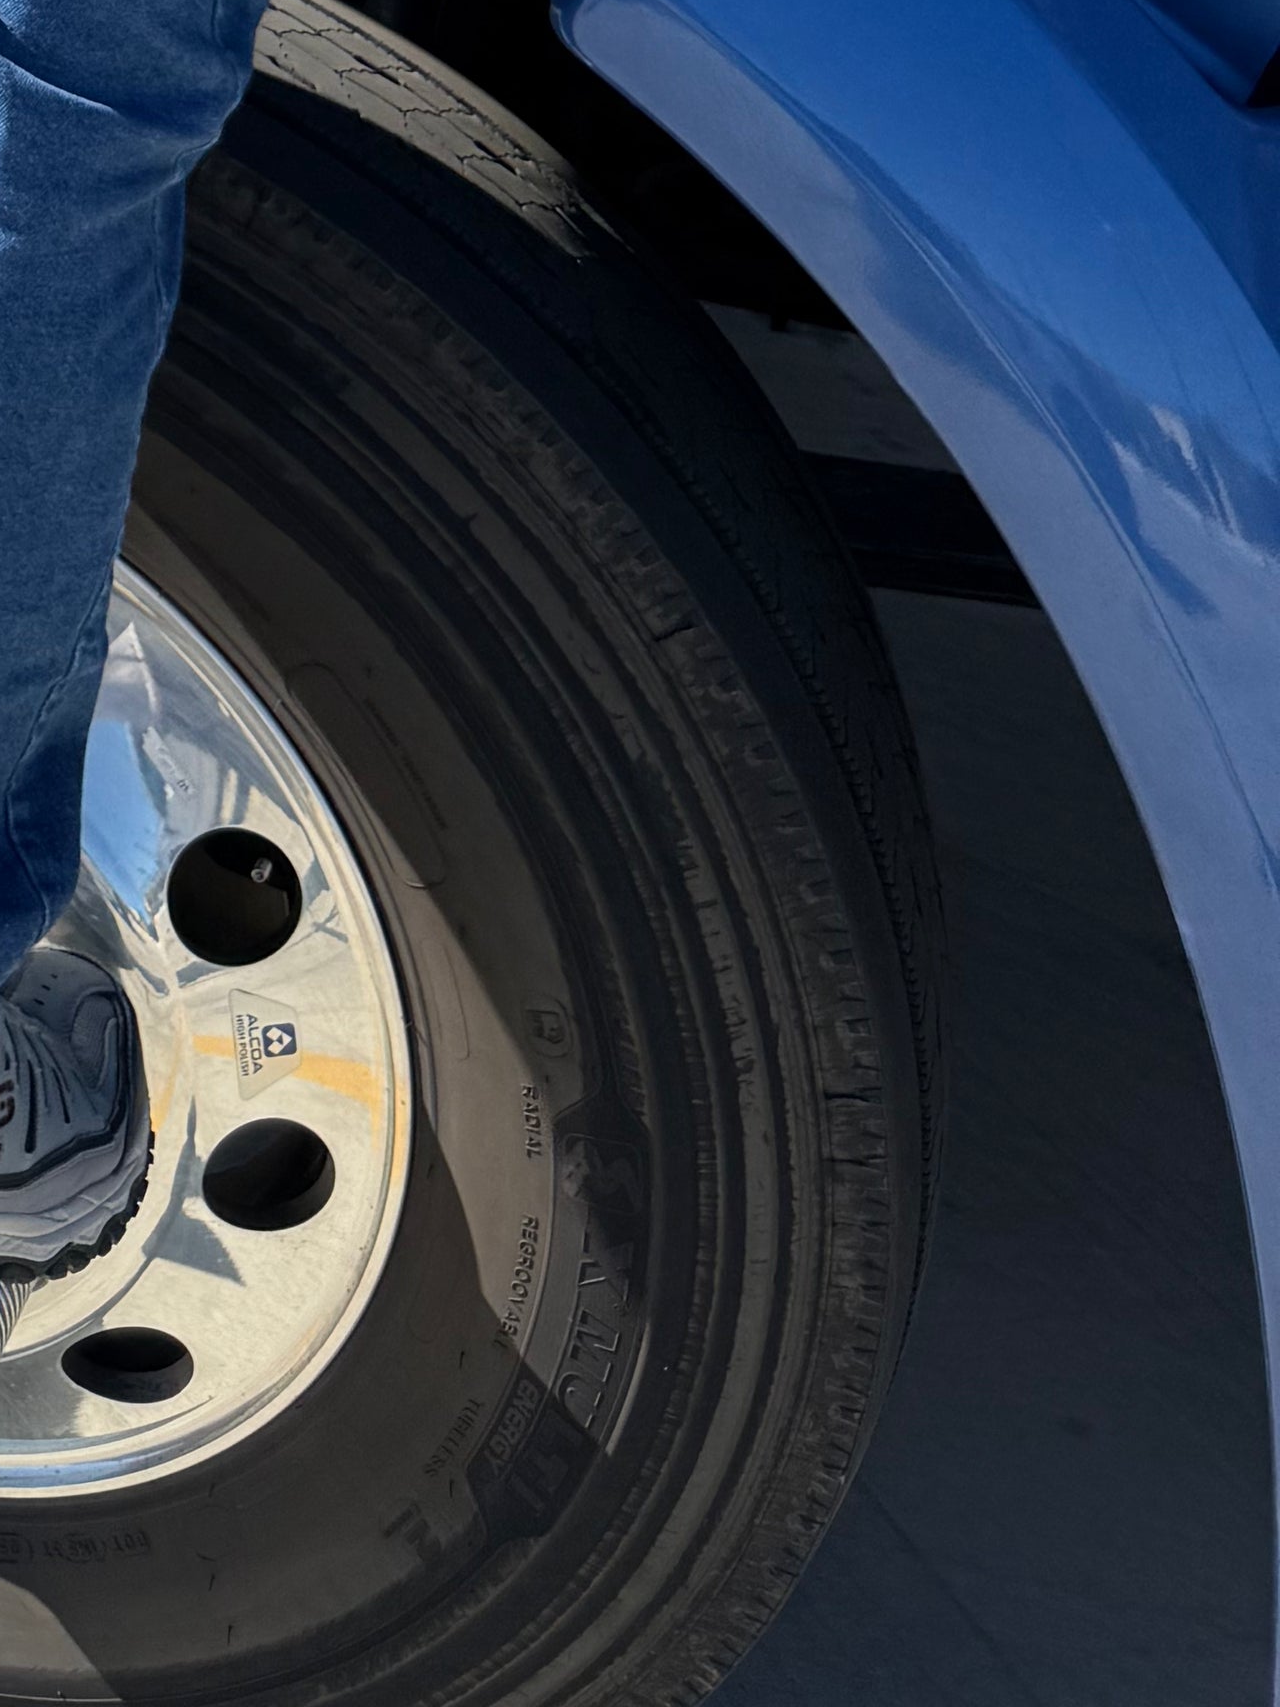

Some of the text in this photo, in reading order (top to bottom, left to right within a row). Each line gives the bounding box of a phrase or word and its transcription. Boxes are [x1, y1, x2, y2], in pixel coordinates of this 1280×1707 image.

[238, 1042, 250, 1077] POLISH
[246, 1013, 264, 1075] ALCOA
[521, 1084, 543, 1160] RADIAL
[483, 1377, 539, 1477] ENERGY
